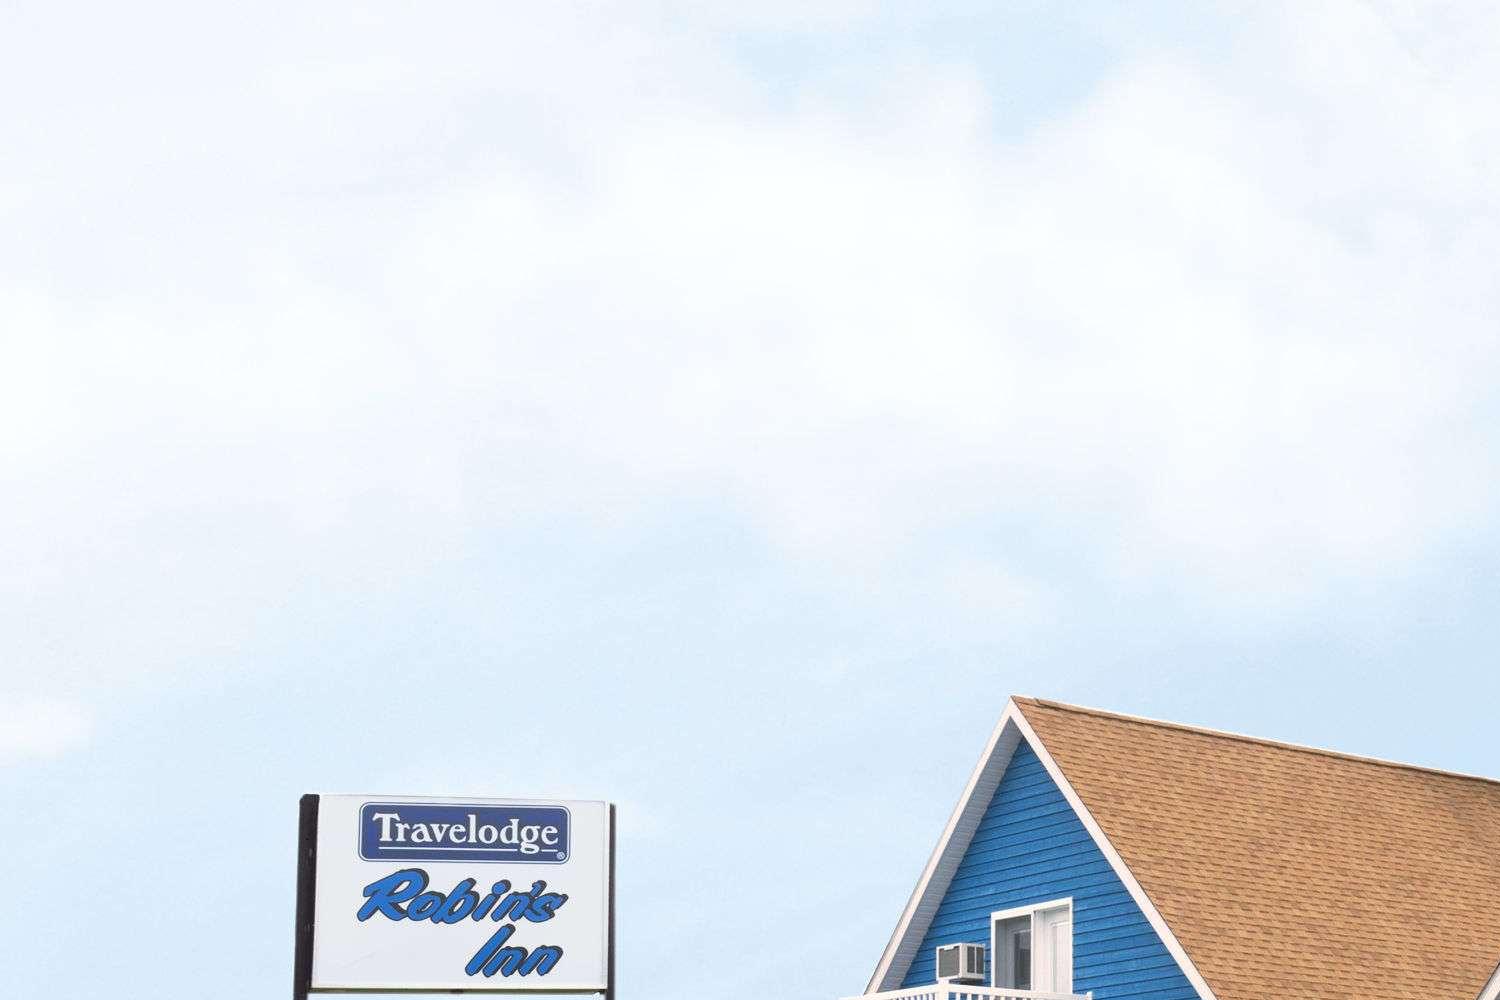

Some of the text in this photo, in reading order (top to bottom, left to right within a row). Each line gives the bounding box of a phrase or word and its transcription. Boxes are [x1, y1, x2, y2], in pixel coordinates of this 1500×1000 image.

[373, 812, 559, 854] Travelodge
[357, 868, 569, 924] Robin's
[465, 924, 563, 977] Inn
